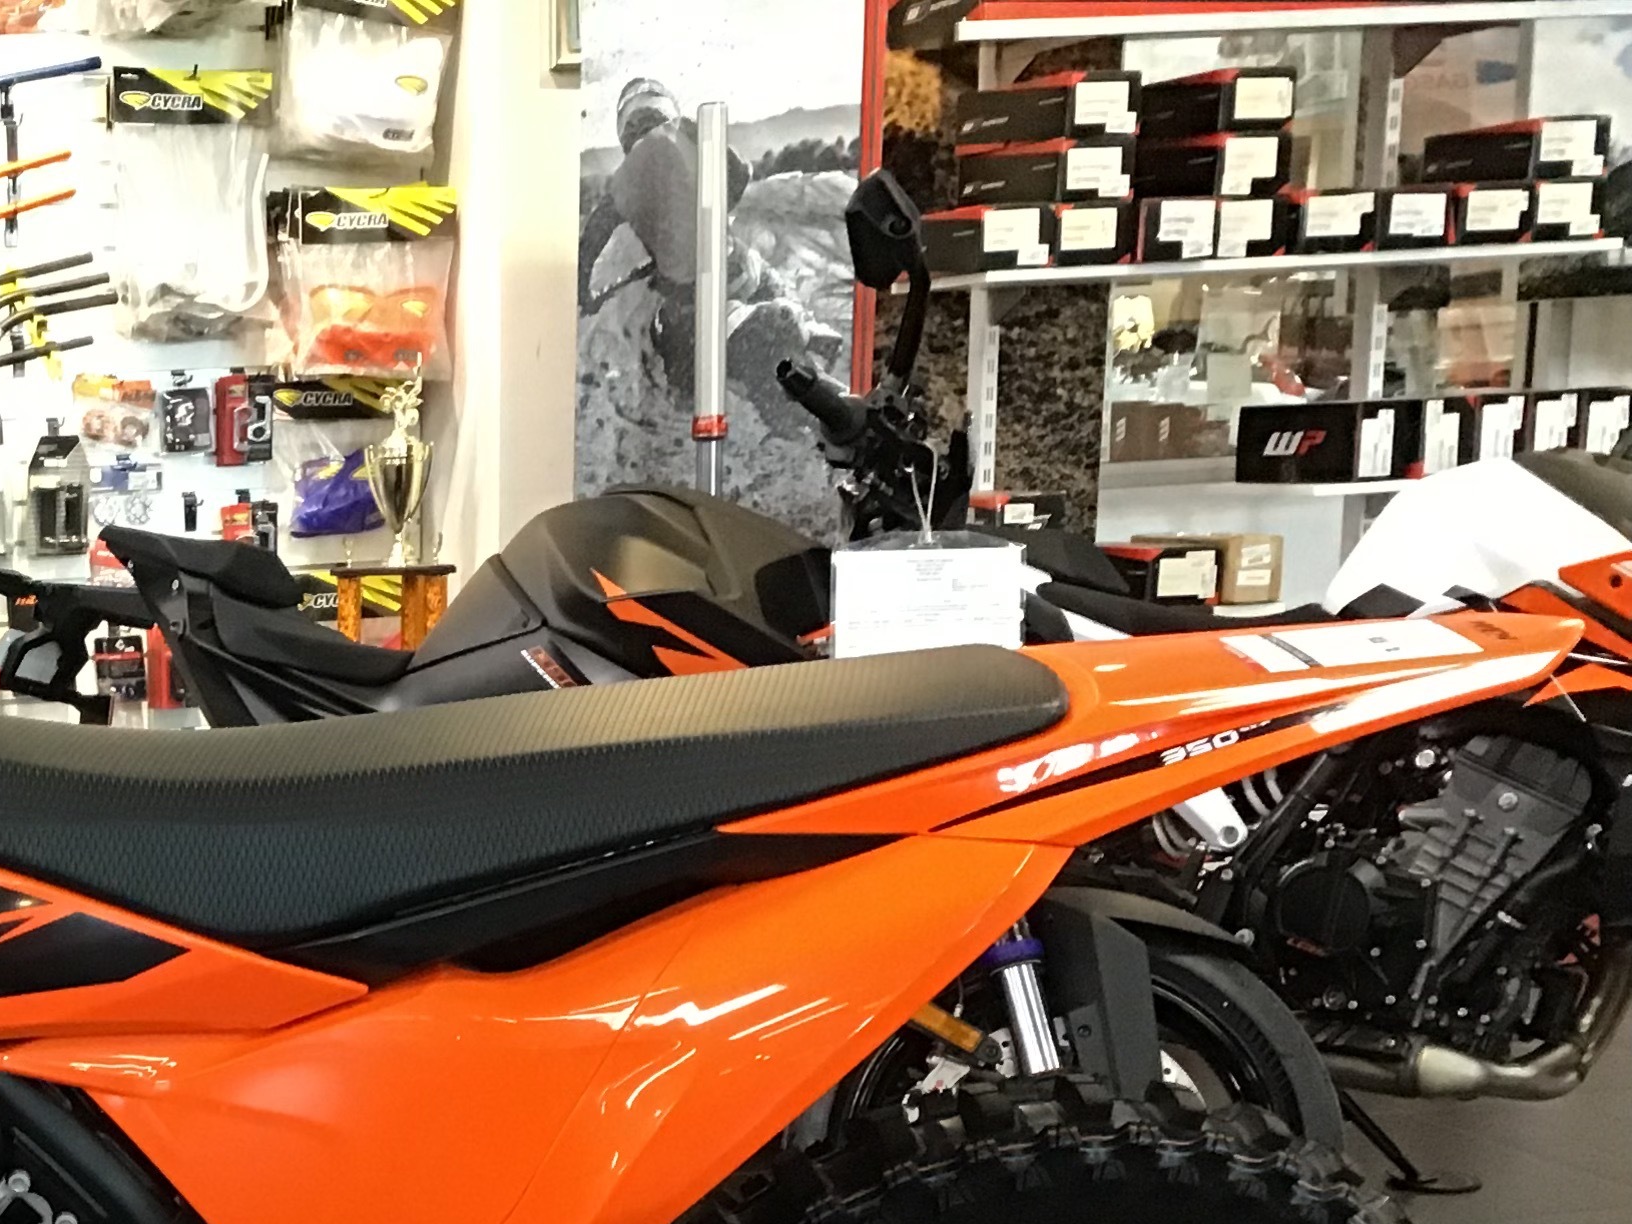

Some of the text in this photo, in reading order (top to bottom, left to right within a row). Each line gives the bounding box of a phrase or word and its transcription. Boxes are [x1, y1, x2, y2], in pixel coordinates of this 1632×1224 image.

[151, 93, 204, 111] CYCRA
[336, 212, 389, 230] CYCRA
[302, 391, 353, 406] CYCRA
[1262, 429, 1327, 456] WP
[312, 592, 339, 609] CYC
[1160, 729, 1240, 766] 350
